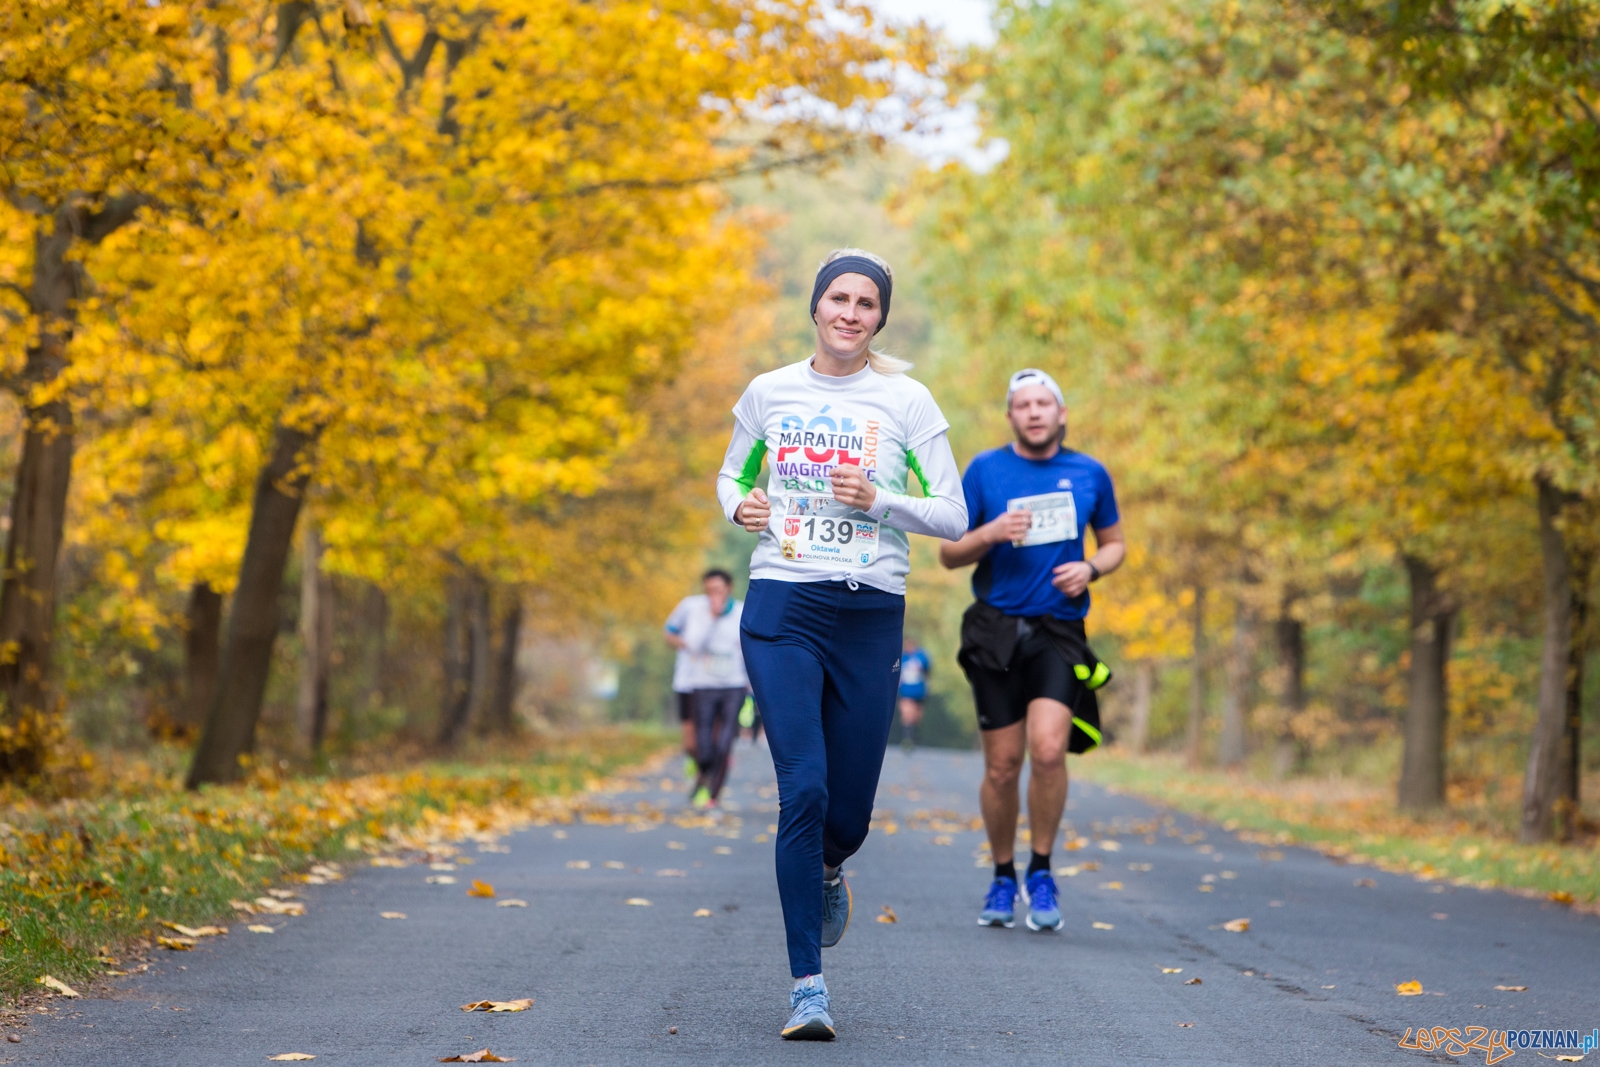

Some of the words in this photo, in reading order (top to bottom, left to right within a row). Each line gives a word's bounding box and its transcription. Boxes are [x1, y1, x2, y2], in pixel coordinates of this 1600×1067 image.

[780, 431, 863, 450] MARATON
[863, 420, 880, 468] SKOKI
[776, 462, 876, 482] WĄGROC
[804, 517, 854, 545] 139
[802, 553, 830, 561] POLINOVA
[831, 556, 853, 564] POLSKA
[810, 544, 841, 554] Oktawia
